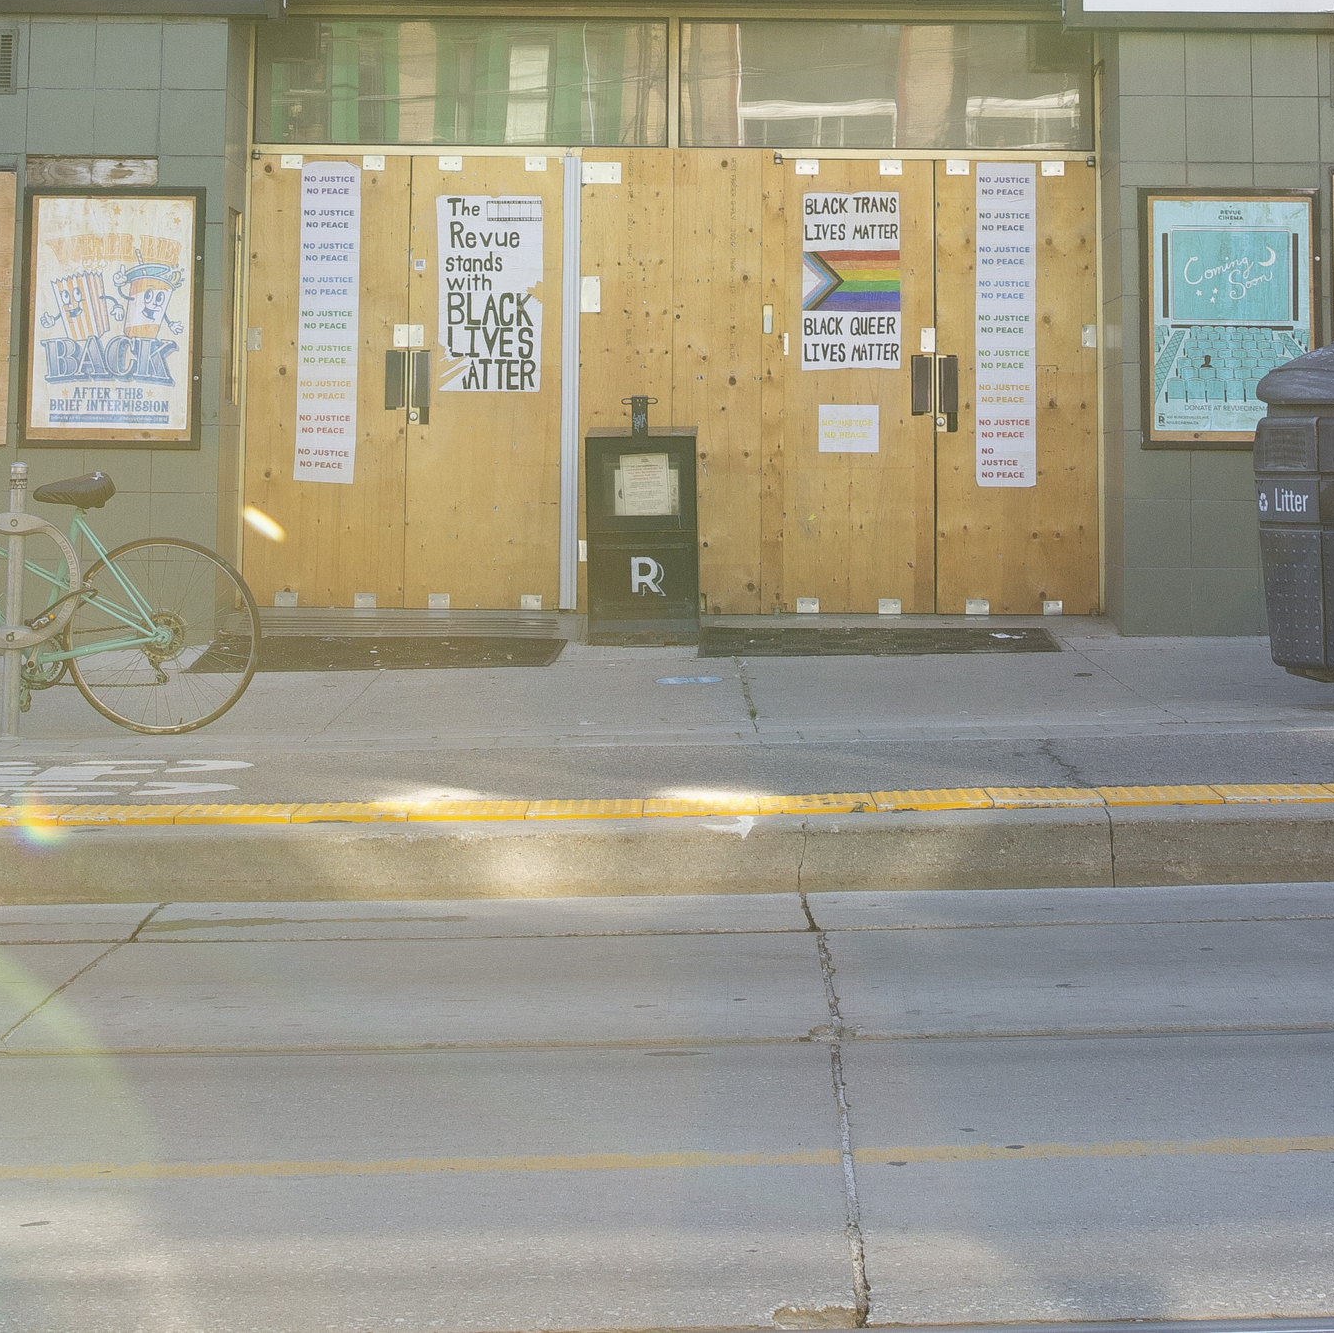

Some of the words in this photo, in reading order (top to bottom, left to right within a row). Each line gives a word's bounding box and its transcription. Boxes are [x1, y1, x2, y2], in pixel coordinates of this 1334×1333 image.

[447, 198, 480, 216] The
[805, 197, 849, 215] BLACK
[853, 197, 897, 214] TRANS
[450, 221, 520, 248] Revue
[805, 224, 845, 241] LIVES
[853, 224, 898, 240] MATTER
[139, 234, 182, 266] BE
[445, 251, 503, 272] stands
[1184, 256, 1254, 285] Coming
[446, 274, 492, 291] with
[1228, 269, 1273, 300] Soon
[447, 293, 533, 327] BLACK
[804, 317, 843, 335] BLACK
[850, 316, 896, 335] QUEER
[447, 326, 533, 359] LIVES
[804, 343, 845, 362] LIVES
[851, 343, 899, 362] MATTER
[40, 336, 180, 387] BACK
[462, 358, 536, 391] ATTER
[73, 387, 110, 399] AFTER
[116, 388, 143, 399] THIS
[50, 399, 82, 411] BRIEF
[86, 399, 169, 412] INTERMISSION
[313, 449, 349, 457] JUSTICE
[1274, 488, 1309, 513] Litter
[631, 556, 666, 596] R
